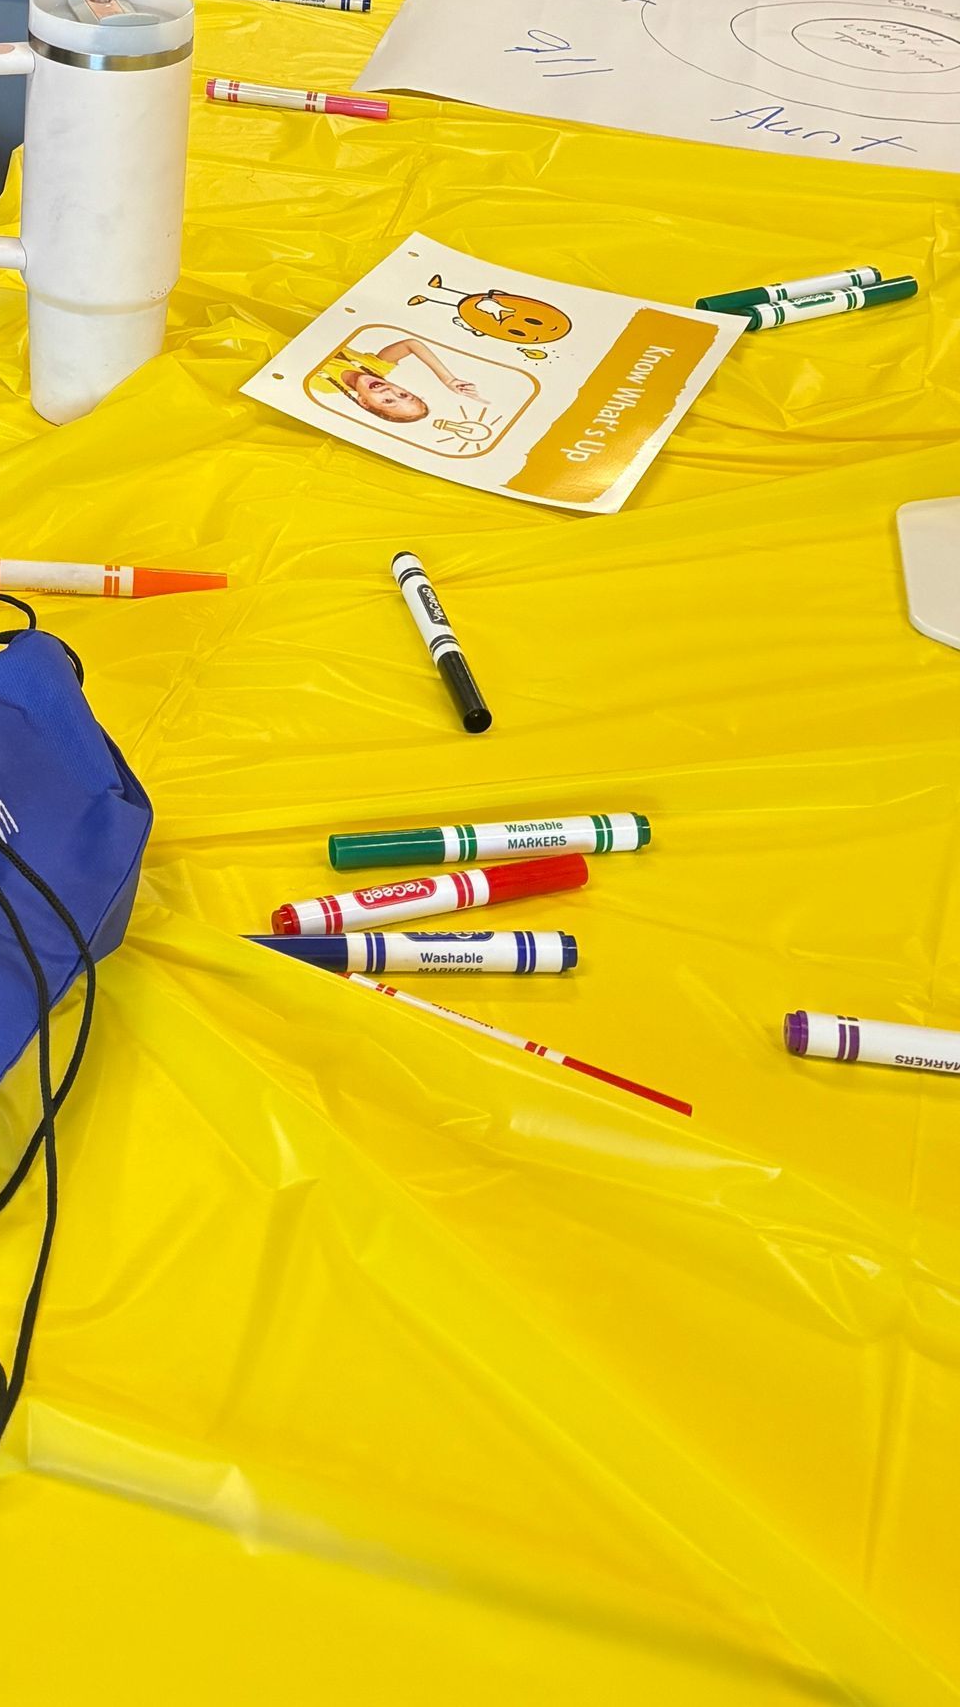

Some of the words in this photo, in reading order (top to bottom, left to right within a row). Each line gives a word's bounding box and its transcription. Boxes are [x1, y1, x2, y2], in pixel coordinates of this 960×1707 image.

[504, 29, 614, 78] 911
[709, 105, 918, 153] Aunt
[626, 345, 676, 385] Know
[584, 387, 647, 438] What's
[559, 439, 606, 462] Up
[505, 820, 564, 833] Washable
[507, 835, 568, 850] MARKERS
[420, 952, 484, 964] Washable
